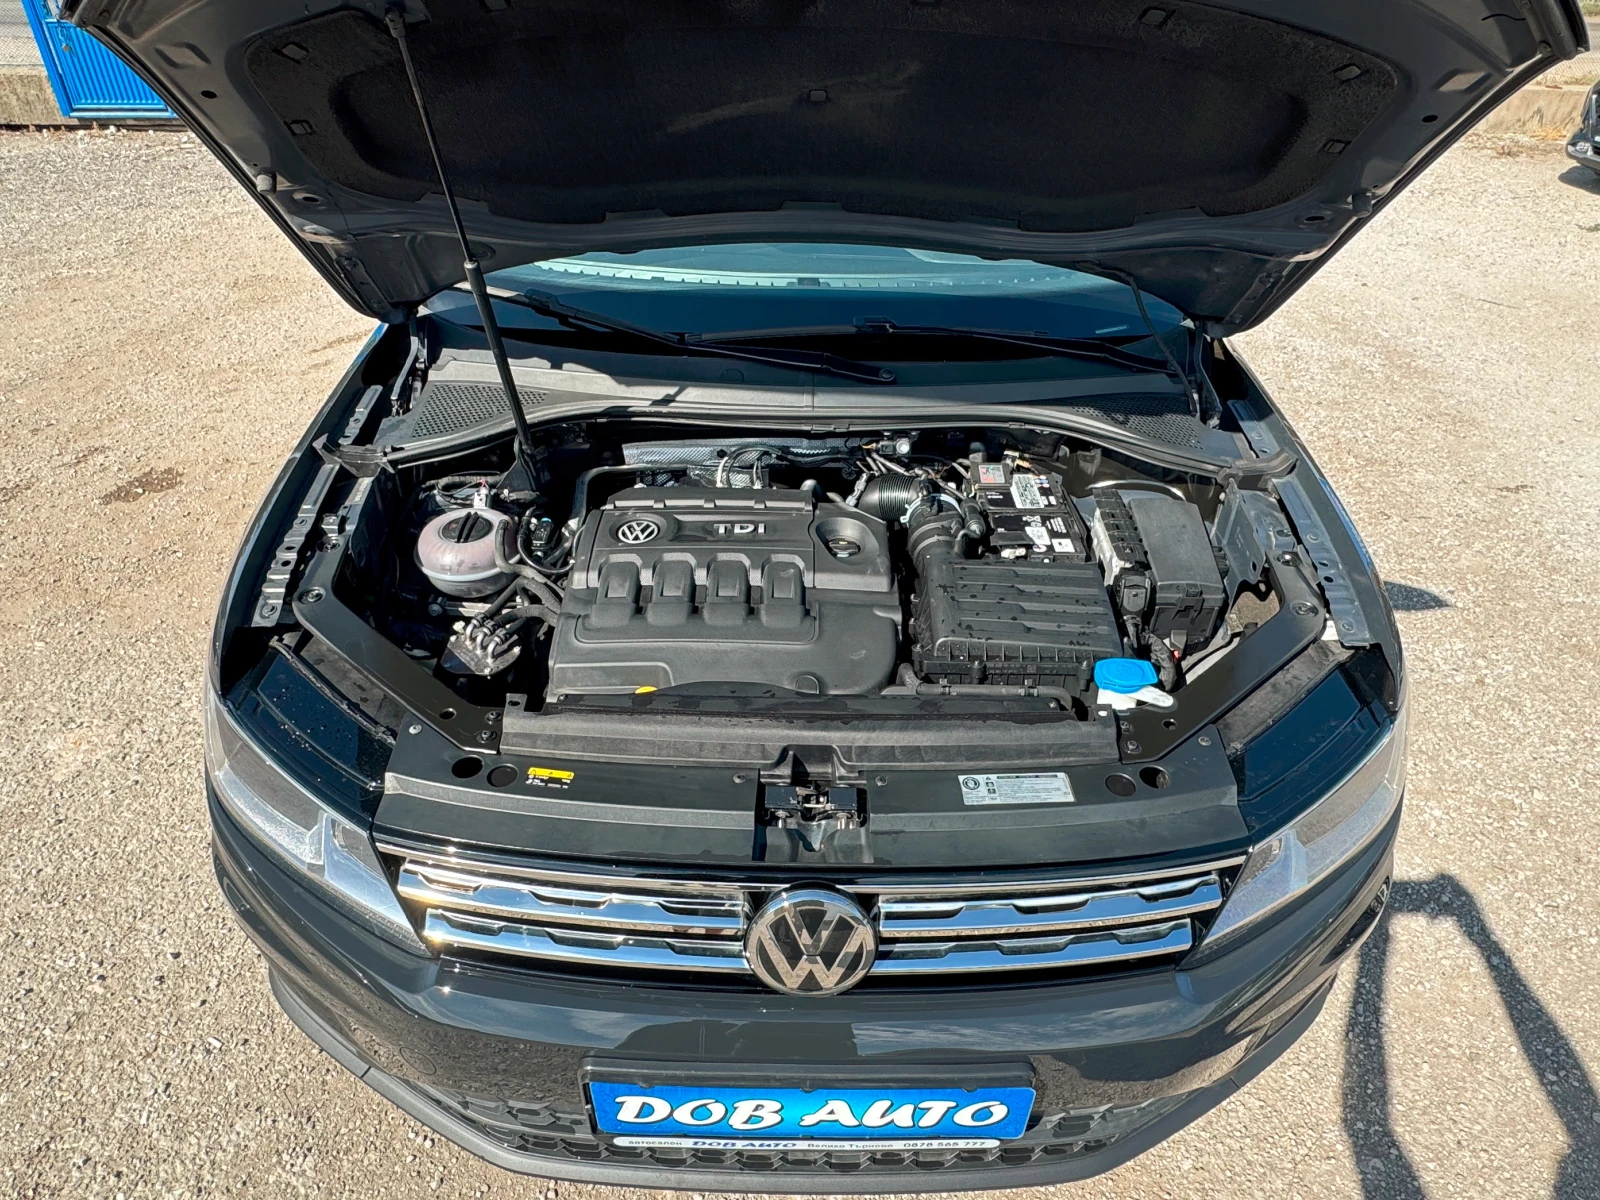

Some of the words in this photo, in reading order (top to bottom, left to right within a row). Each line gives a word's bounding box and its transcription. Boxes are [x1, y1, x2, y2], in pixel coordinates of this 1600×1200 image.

[713, 523, 765, 536] TDI
[615, 1096, 783, 1131] DOB
[800, 1100, 1010, 1129] AUTO
[692, 1140, 737, 1148] DOB
